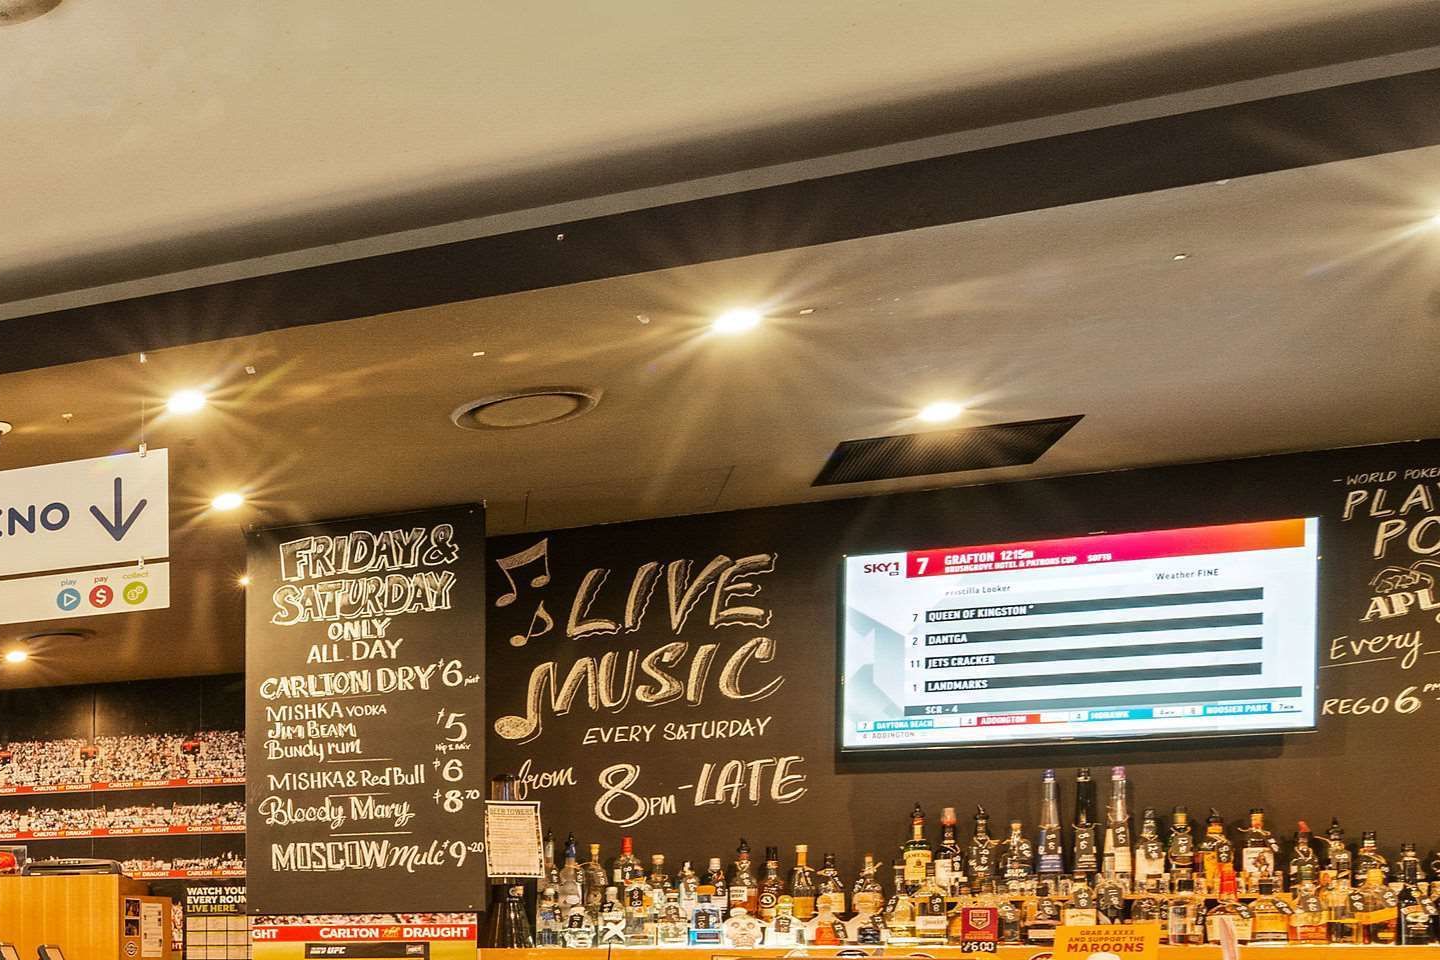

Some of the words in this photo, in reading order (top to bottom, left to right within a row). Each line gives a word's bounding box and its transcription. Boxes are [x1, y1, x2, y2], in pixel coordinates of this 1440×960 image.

[1346, 471, 1397, 486] WORLD
[1341, 483, 1440, 521] PLA
[280, 528, 426, 582] FRIDAY
[422, 523, 459, 566] &
[944, 551, 994, 565] GRAFTON
[1000, 550, 1034, 561] 1215m
[916, 557, 929, 575] 7
[1061, 556, 1077, 565] CUP
[122, 570, 149, 580] collect
[864, 562, 900, 575] SKY1
[1156, 570, 1194, 581] Weather
[1197, 568, 1219, 577] FINE
[60, 578, 77, 587] play
[94, 575, 108, 584] pay
[566, 552, 779, 640] LIVE
[982, 585, 1010, 594] Looker
[270, 570, 457, 626] SATURDAY
[1359, 588, 1440, 622] APL
[912, 613, 919, 622] 7
[928, 611, 960, 621] QUEEN
[962, 610, 975, 619] OF
[977, 606, 1027, 618] KINGSTON
[327, 617, 392, 641] ONLY
[912, 637, 918, 645] 2
[928, 634, 967, 645] DANTGA
[306, 644, 345, 664] ALL
[352, 638, 404, 661] DAY
[1330, 630, 1423, 669] Every
[910, 660, 920, 668] 11
[928, 658, 949, 668] JETS
[951, 655, 995, 667] CRACKER
[260, 669, 371, 700] CARLTON
[376, 663, 437, 692] DRY
[913, 684, 917, 692] 1
[928, 679, 988, 691] LANDMARKS
[495, 636, 786, 745] MUSIC
[266, 702, 342, 722] MISHKA
[346, 704, 387, 718] VODKA
[925, 706, 942, 714] SCR
[951, 705, 958, 713] 4
[1206, 705, 1244, 715] HOOSIER
[1246, 703, 1268, 713] PARK
[1321, 696, 1390, 716] REGO
[876, 721, 908, 730] DAYTONA
[910, 720, 933, 728] BEACH
[980, 715, 1027, 724] ADDINGTON
[582, 724, 657, 744] EVERY
[664, 716, 772, 741] SATURDAY
[327, 737, 363, 755] rum
[267, 772, 344, 791] MISHKA
[346, 771, 358, 787] &
[360, 767, 393, 787] Red
[393, 764, 425, 785] Bull
[518, 759, 577, 800] from
[258, 796, 346, 830] Bloody
[351, 795, 416, 827] Mary
[507, 808, 533, 816] TOWERS
[271, 840, 389, 872] MOSCOW
[187, 886, 222, 896] WATCH
[187, 896, 218, 904] EVERY
[187, 904, 208, 912] LIVE
[319, 927, 379, 938] CARLTON
[403, 927, 469, 938] DRAUGHT
[327, 947, 346, 955] UFC
[1067, 943, 1144, 953] MAROONS
